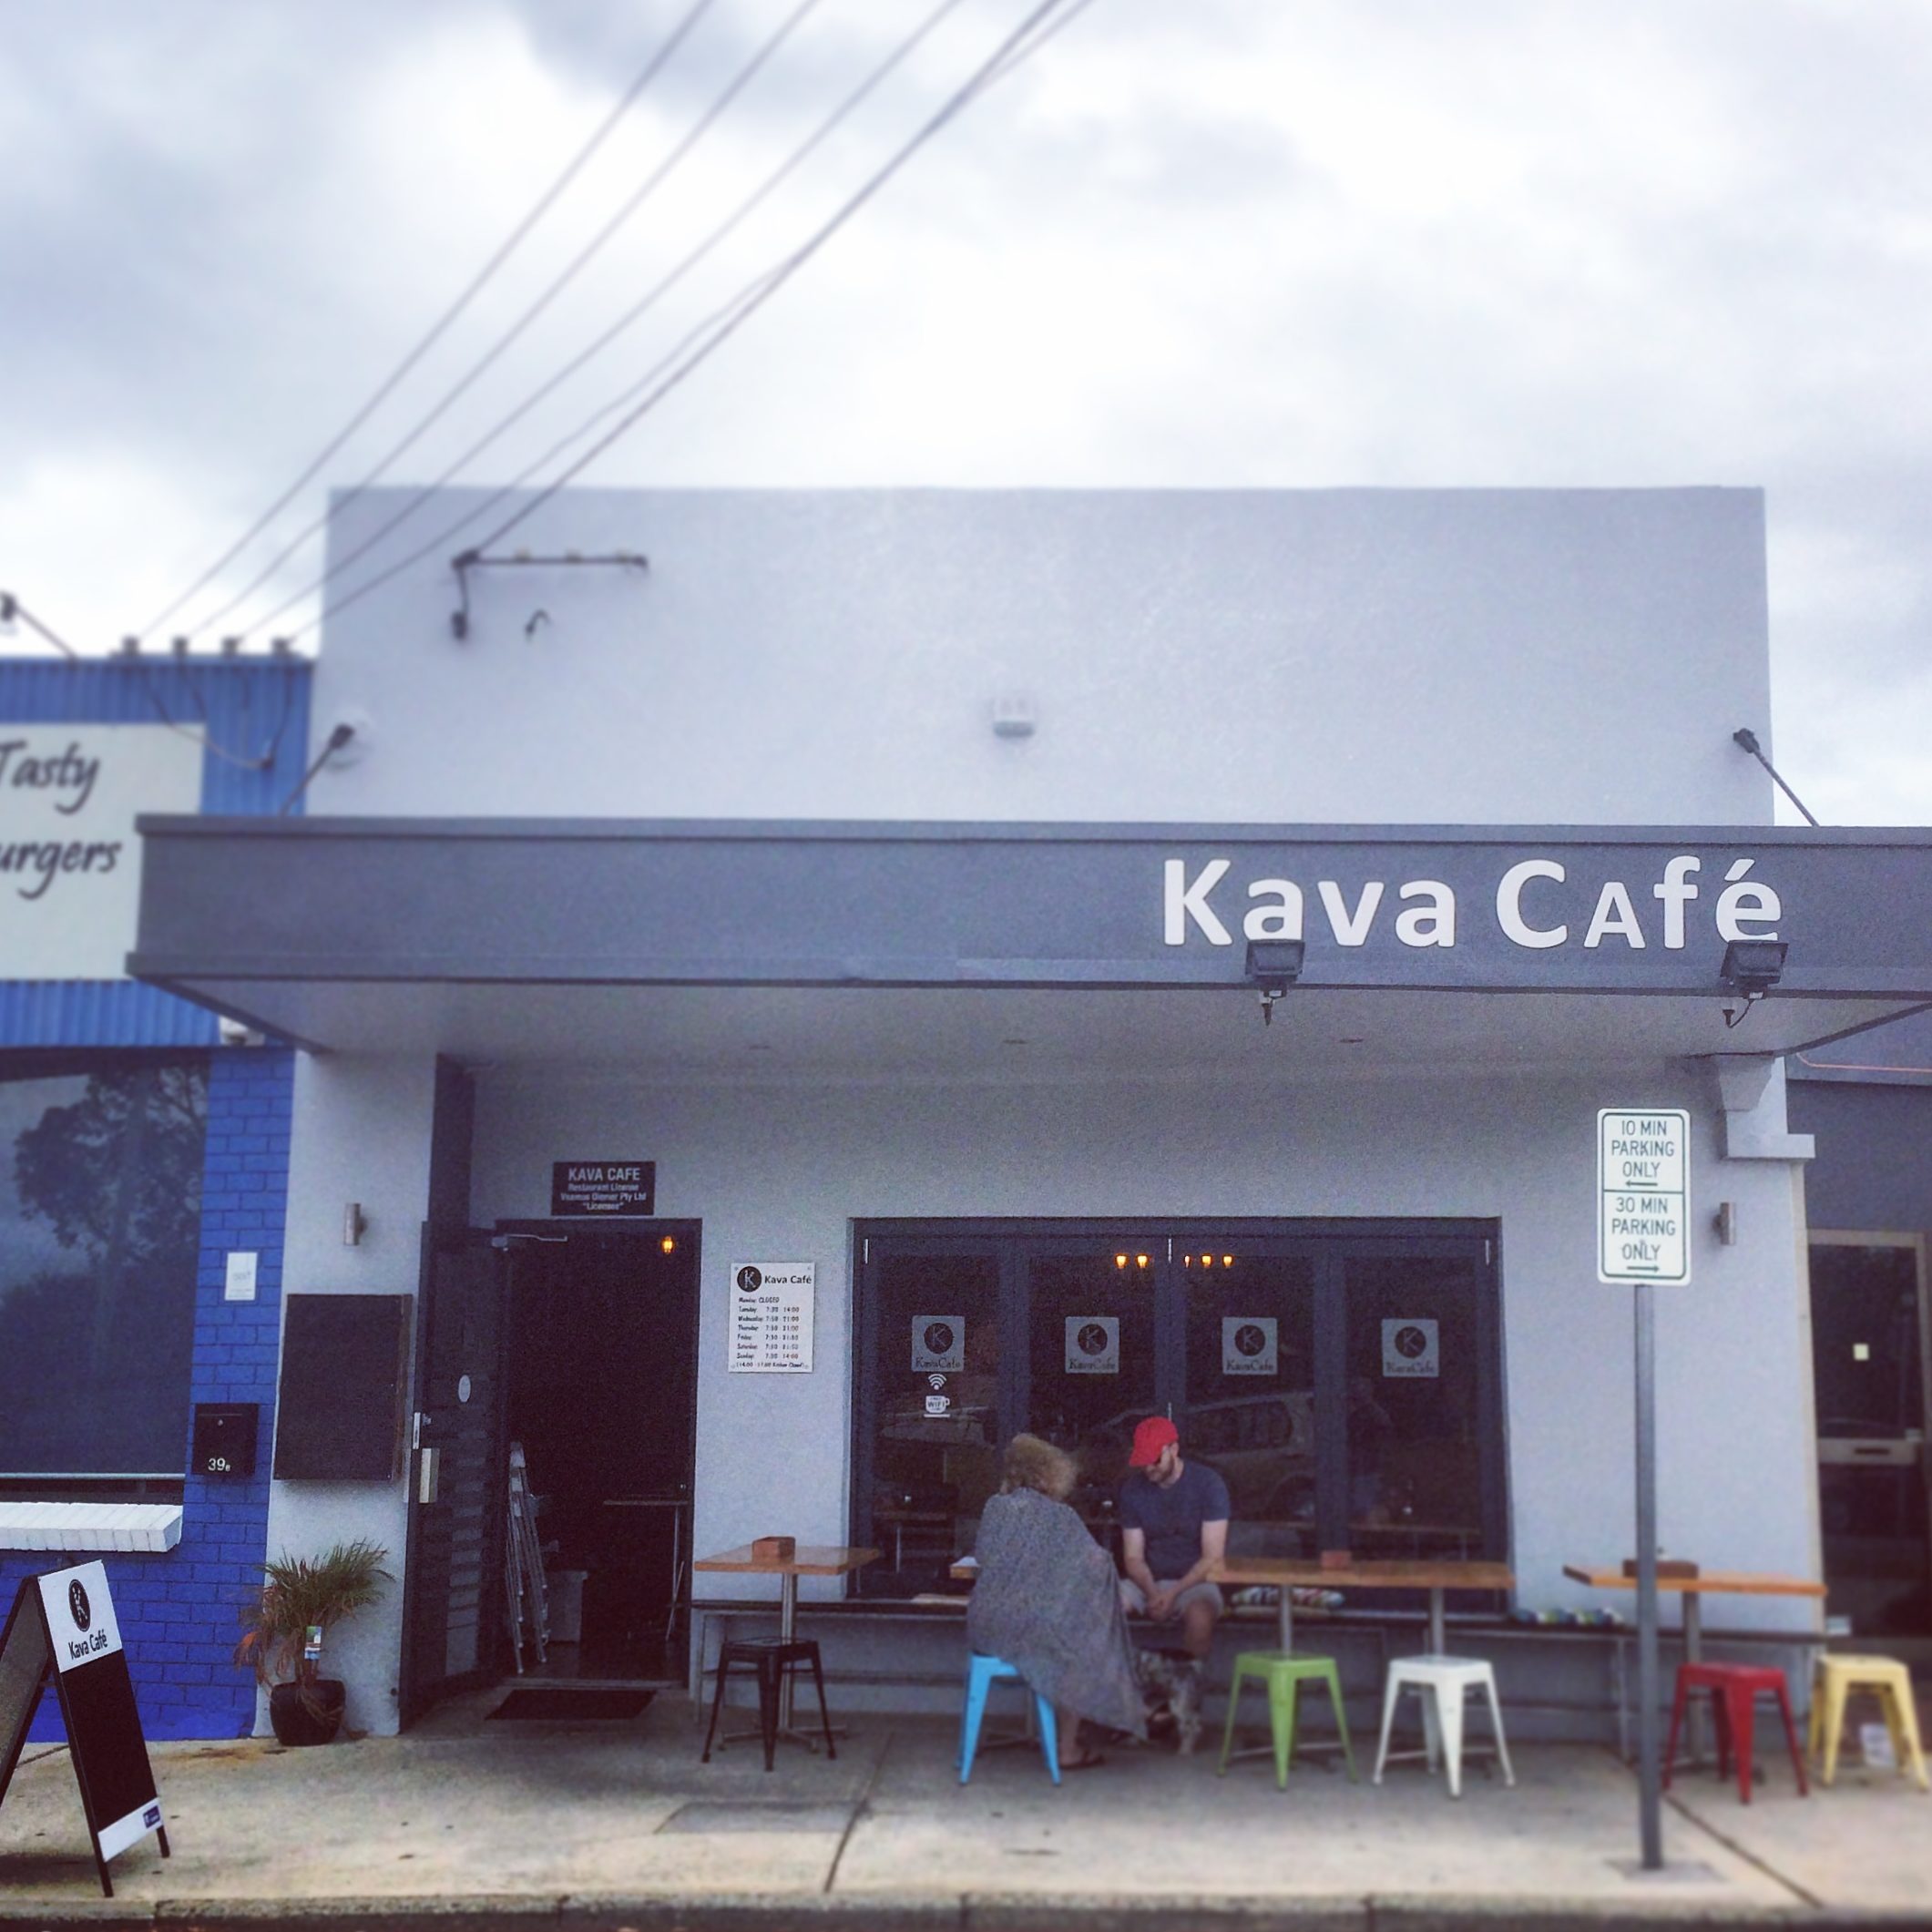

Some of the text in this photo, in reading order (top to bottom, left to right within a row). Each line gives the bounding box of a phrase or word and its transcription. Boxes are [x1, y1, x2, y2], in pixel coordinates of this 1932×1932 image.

[0, 741, 100, 815] Tasty
[1163, 858, 1456, 947] Kava
[1621, 1119, 1667, 1136] 10 MIN
[1611, 1140, 1674, 1157] PARKING
[568, 1168, 640, 1181] KAVA CAFE
[1622, 1161, 1661, 1178] ONLY
[619, 1192, 632, 1202] Pty
[634, 1192, 647, 1201] Ltd
[1615, 1196, 1668, 1214] 30 MIN
[1611, 1218, 1676, 1236] PARKING
[1621, 1242, 1661, 1262] ONLY
[765, 1275, 787, 1284] Kava
[68, 1629, 108, 1660] Kava Café
